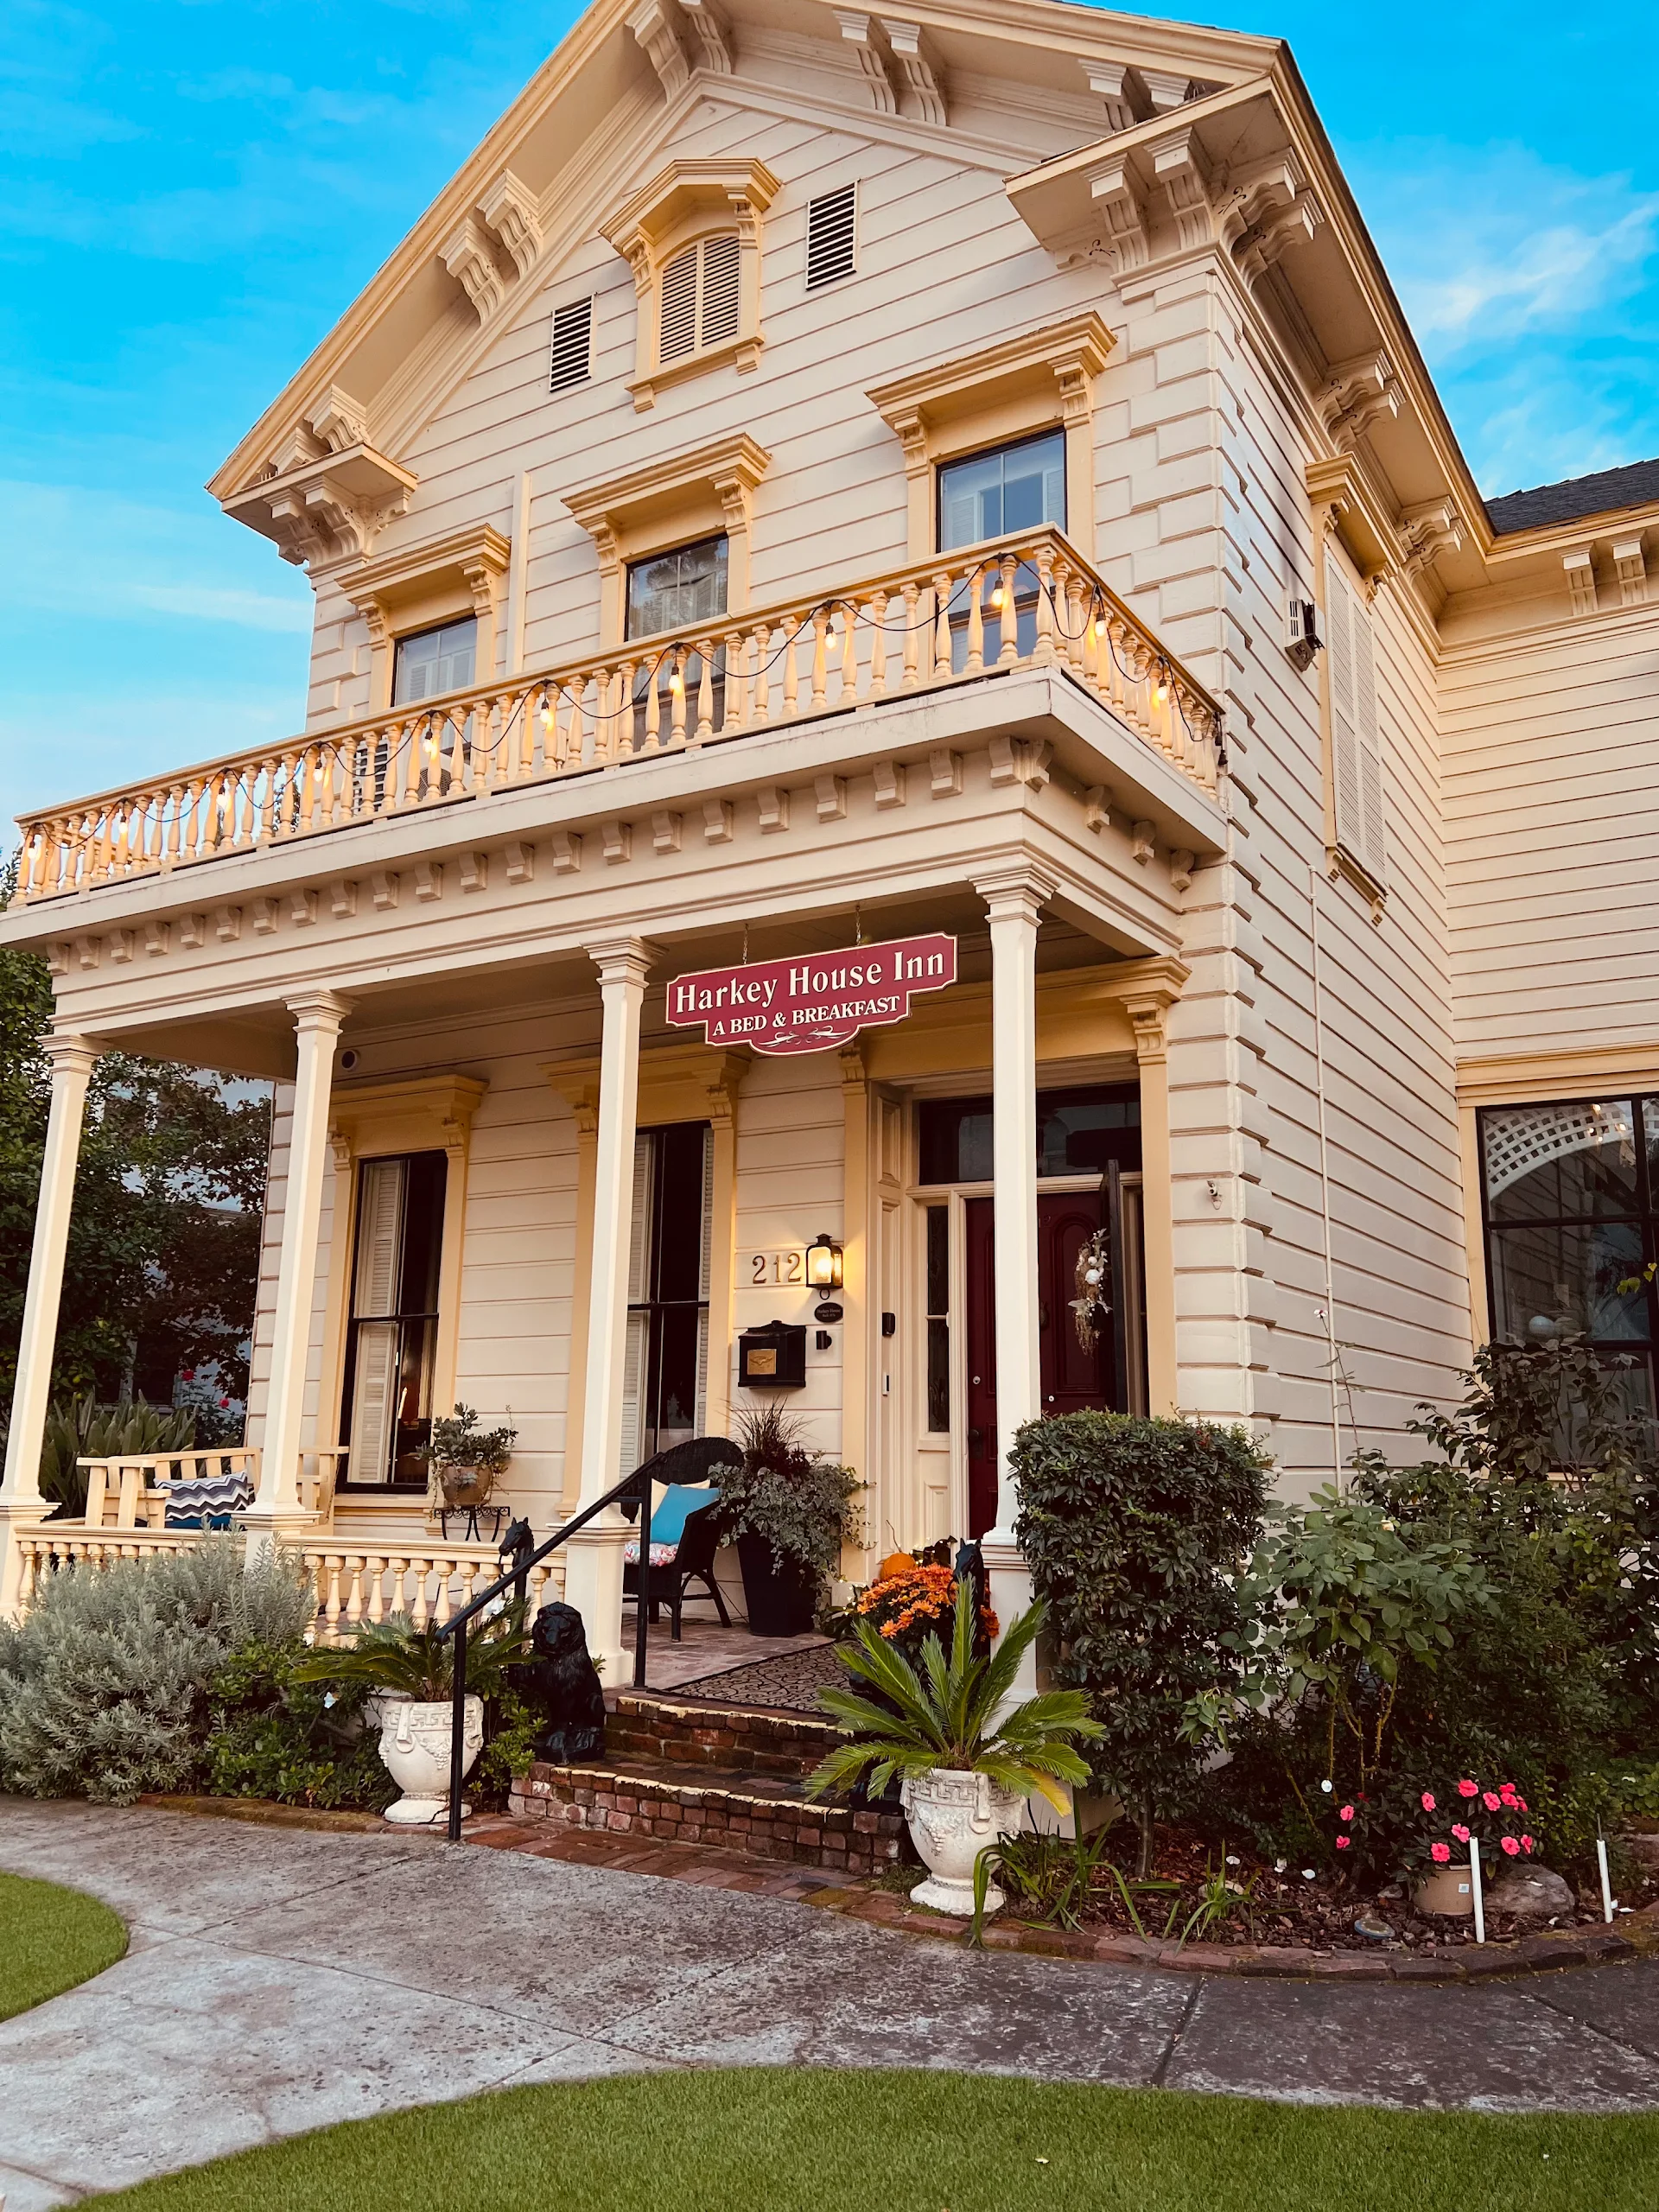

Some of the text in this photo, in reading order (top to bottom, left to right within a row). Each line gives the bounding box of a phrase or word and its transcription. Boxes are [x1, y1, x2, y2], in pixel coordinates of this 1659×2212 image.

[676, 951, 944, 1013] Harkey House Inn
[712, 995, 900, 1036] A BED & BREAKFAST
[752, 1253, 802, 1284] 212
